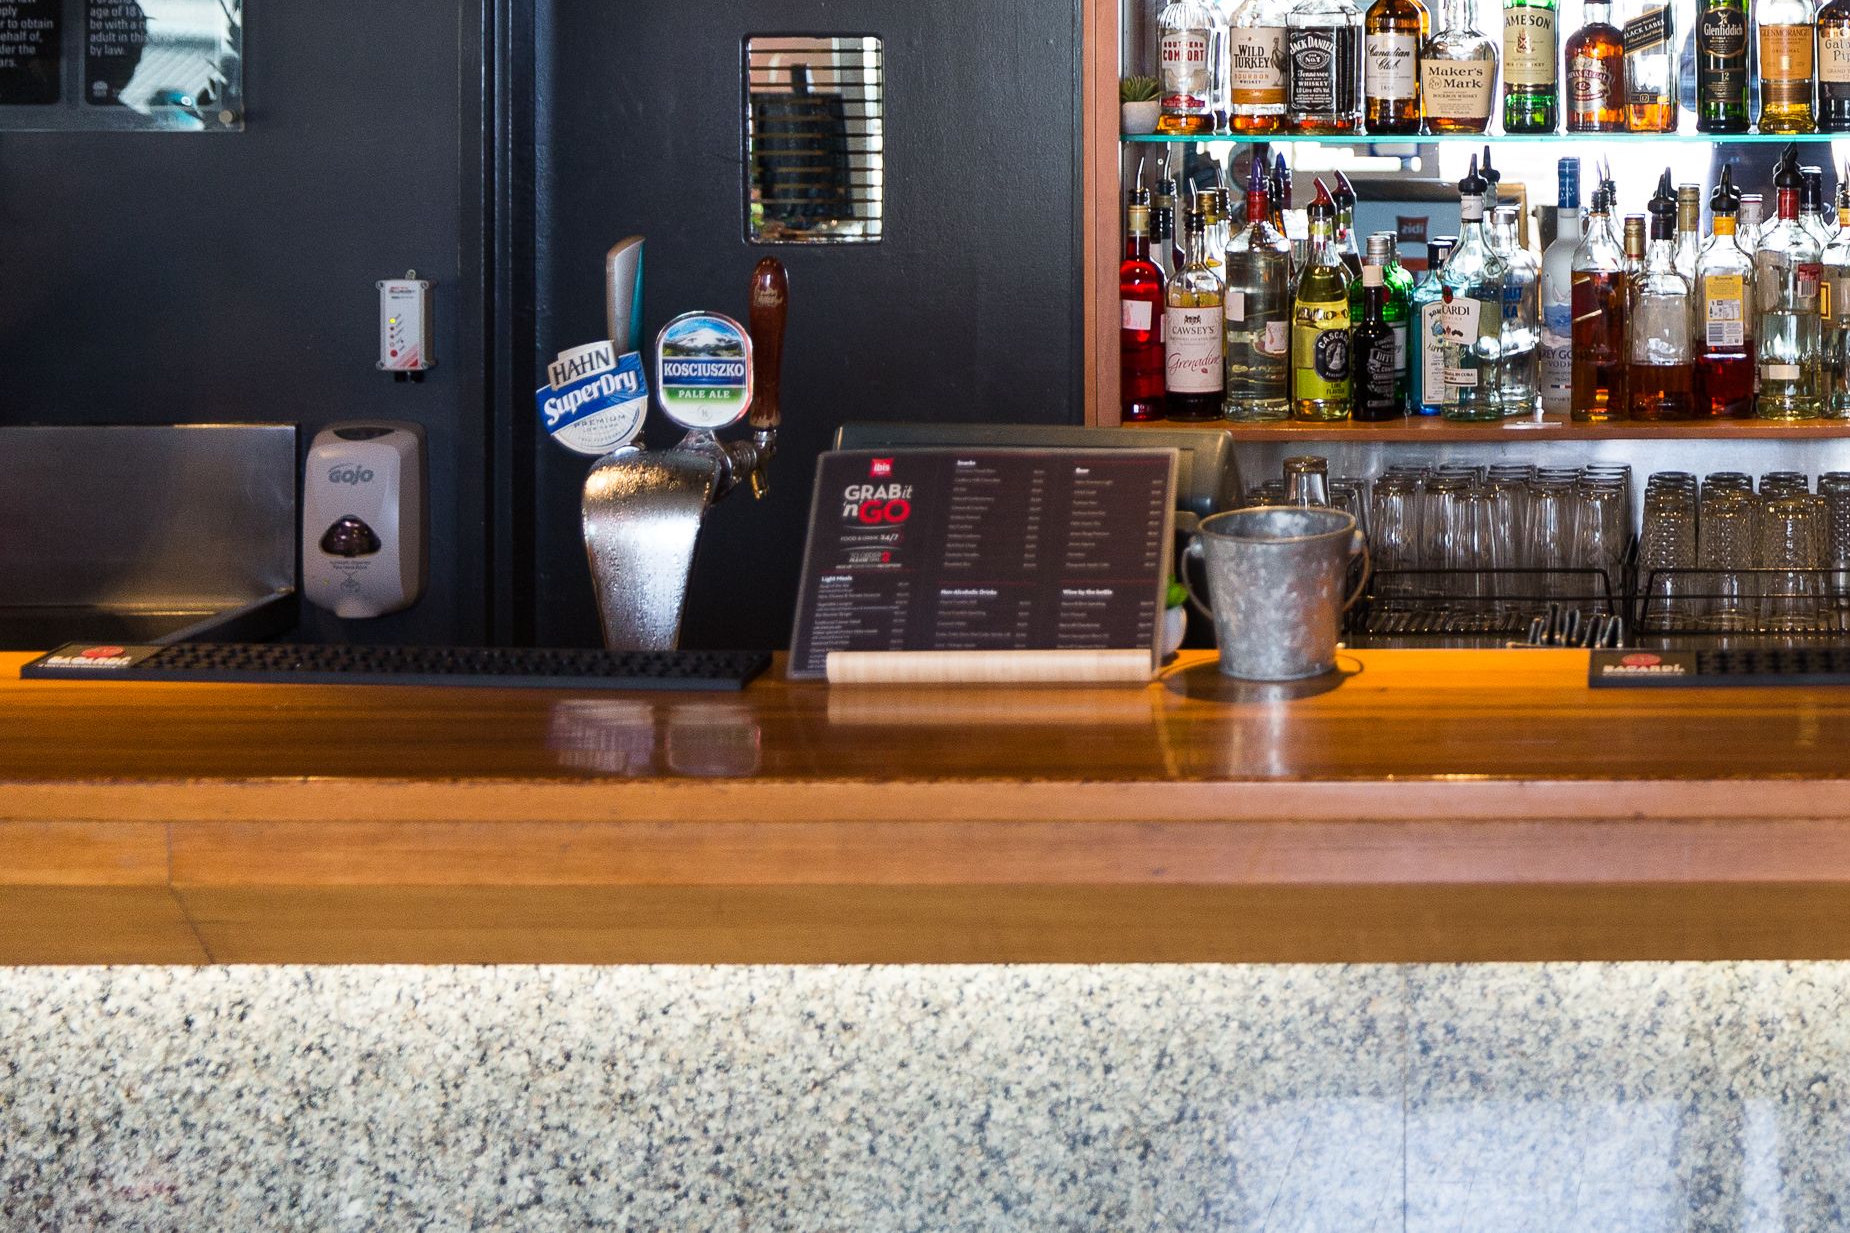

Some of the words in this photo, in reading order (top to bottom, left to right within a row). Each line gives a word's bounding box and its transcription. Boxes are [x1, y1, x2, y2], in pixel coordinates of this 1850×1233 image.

[1505, 14, 1552, 30] AMESON
[1703, 22, 1744, 36] Glenfiddich
[1238, 45, 1264, 56] WILD
[1290, 39, 1308, 55] JACK
[1163, 50, 1204, 62] COMORT
[1234, 54, 1270, 69] TURKEY
[1428, 66, 1484, 77] Maker's
[1443, 79, 1483, 89] Mark
[1172, 326, 1214, 335] CAWSEY'S
[552, 347, 611, 386] HAHN
[663, 363, 745, 377] KOSCIUSZKO
[678, 389, 705, 399] PALE
[709, 389, 731, 399] ALE
[859, 498, 911, 524] GO
